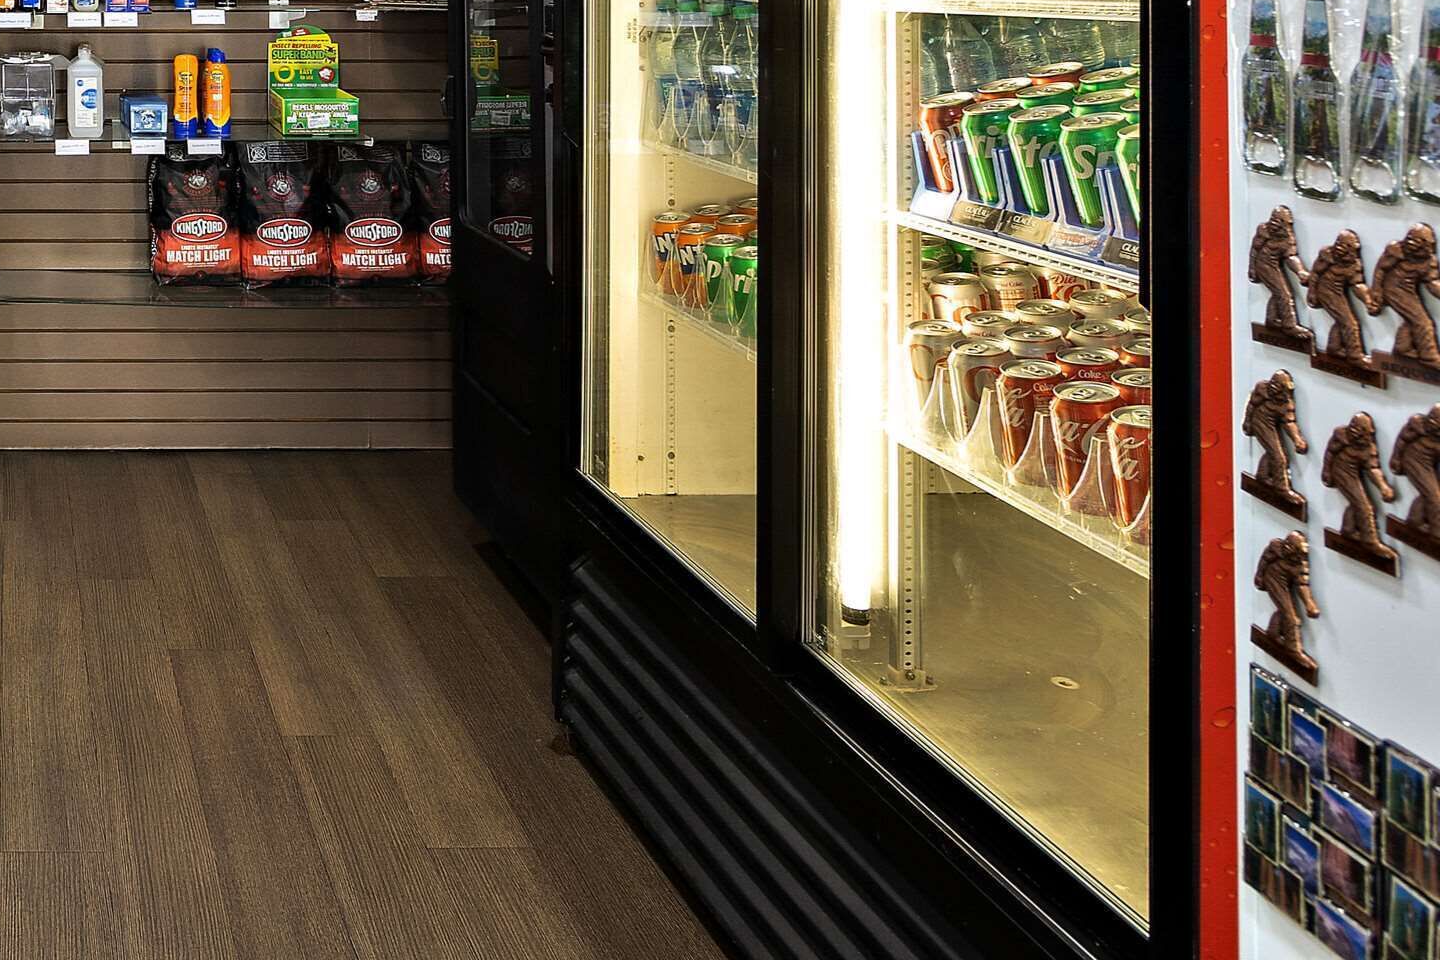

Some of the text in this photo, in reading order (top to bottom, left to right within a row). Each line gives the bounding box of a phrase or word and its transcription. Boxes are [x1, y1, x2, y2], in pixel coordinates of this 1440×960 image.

[176, 218, 223, 237] KINGSFORD
[262, 223, 308, 242] KINGSFORD
[350, 222, 398, 240] KINGSFORD
[166, 248, 232, 262] MATCH LIGHT
[252, 252, 317, 266] MATCH LIGHT
[342, 253, 409, 266] MATCH LIGHT
[426, 254, 452, 265] MATC
[1078, 369, 1101, 379] Coke
